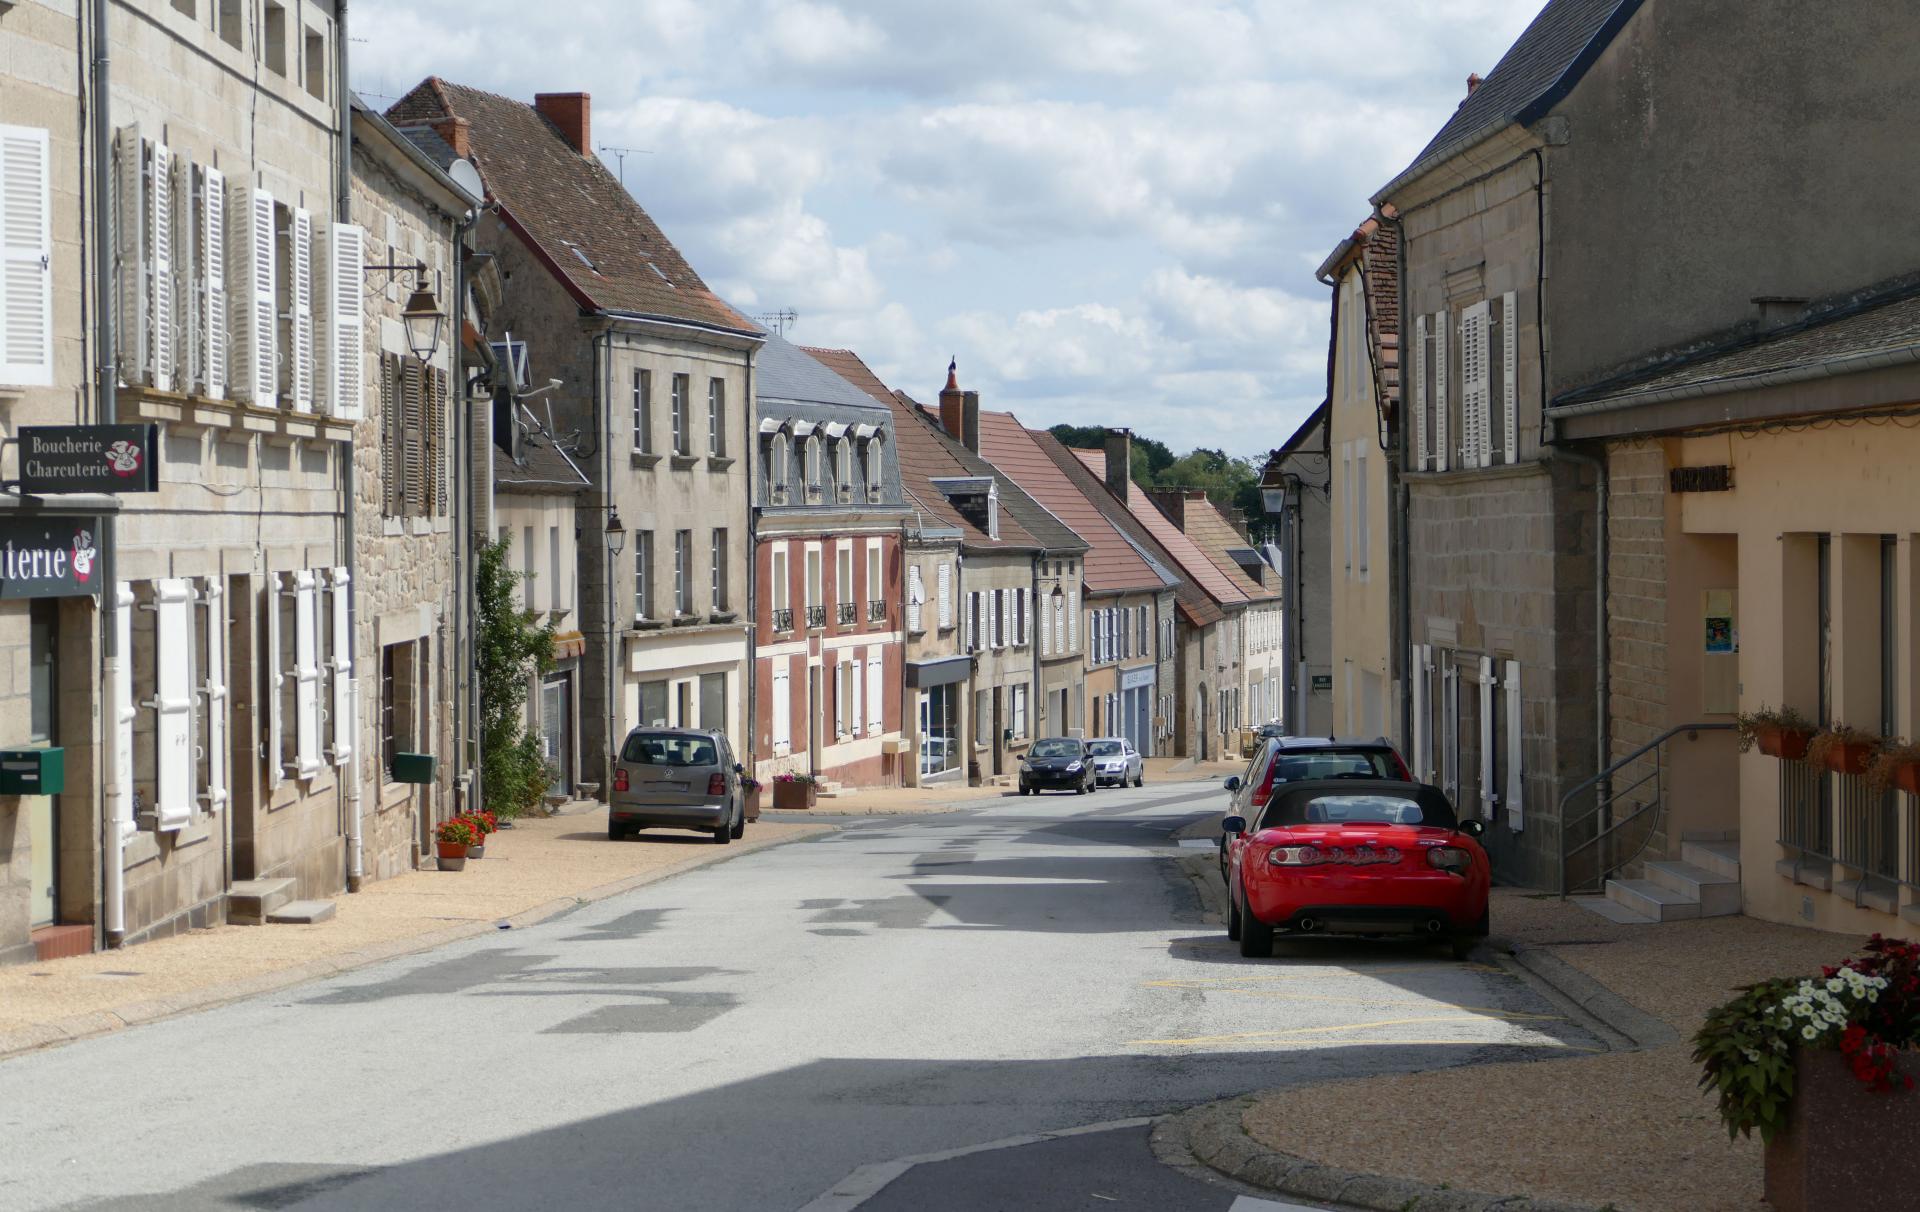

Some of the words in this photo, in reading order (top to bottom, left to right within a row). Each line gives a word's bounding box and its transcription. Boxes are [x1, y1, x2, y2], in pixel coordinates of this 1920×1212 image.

[32, 436, 103, 455] Boucherie
[25, 459, 110, 478] Charcuterie
[0, 531, 67, 580] terie
